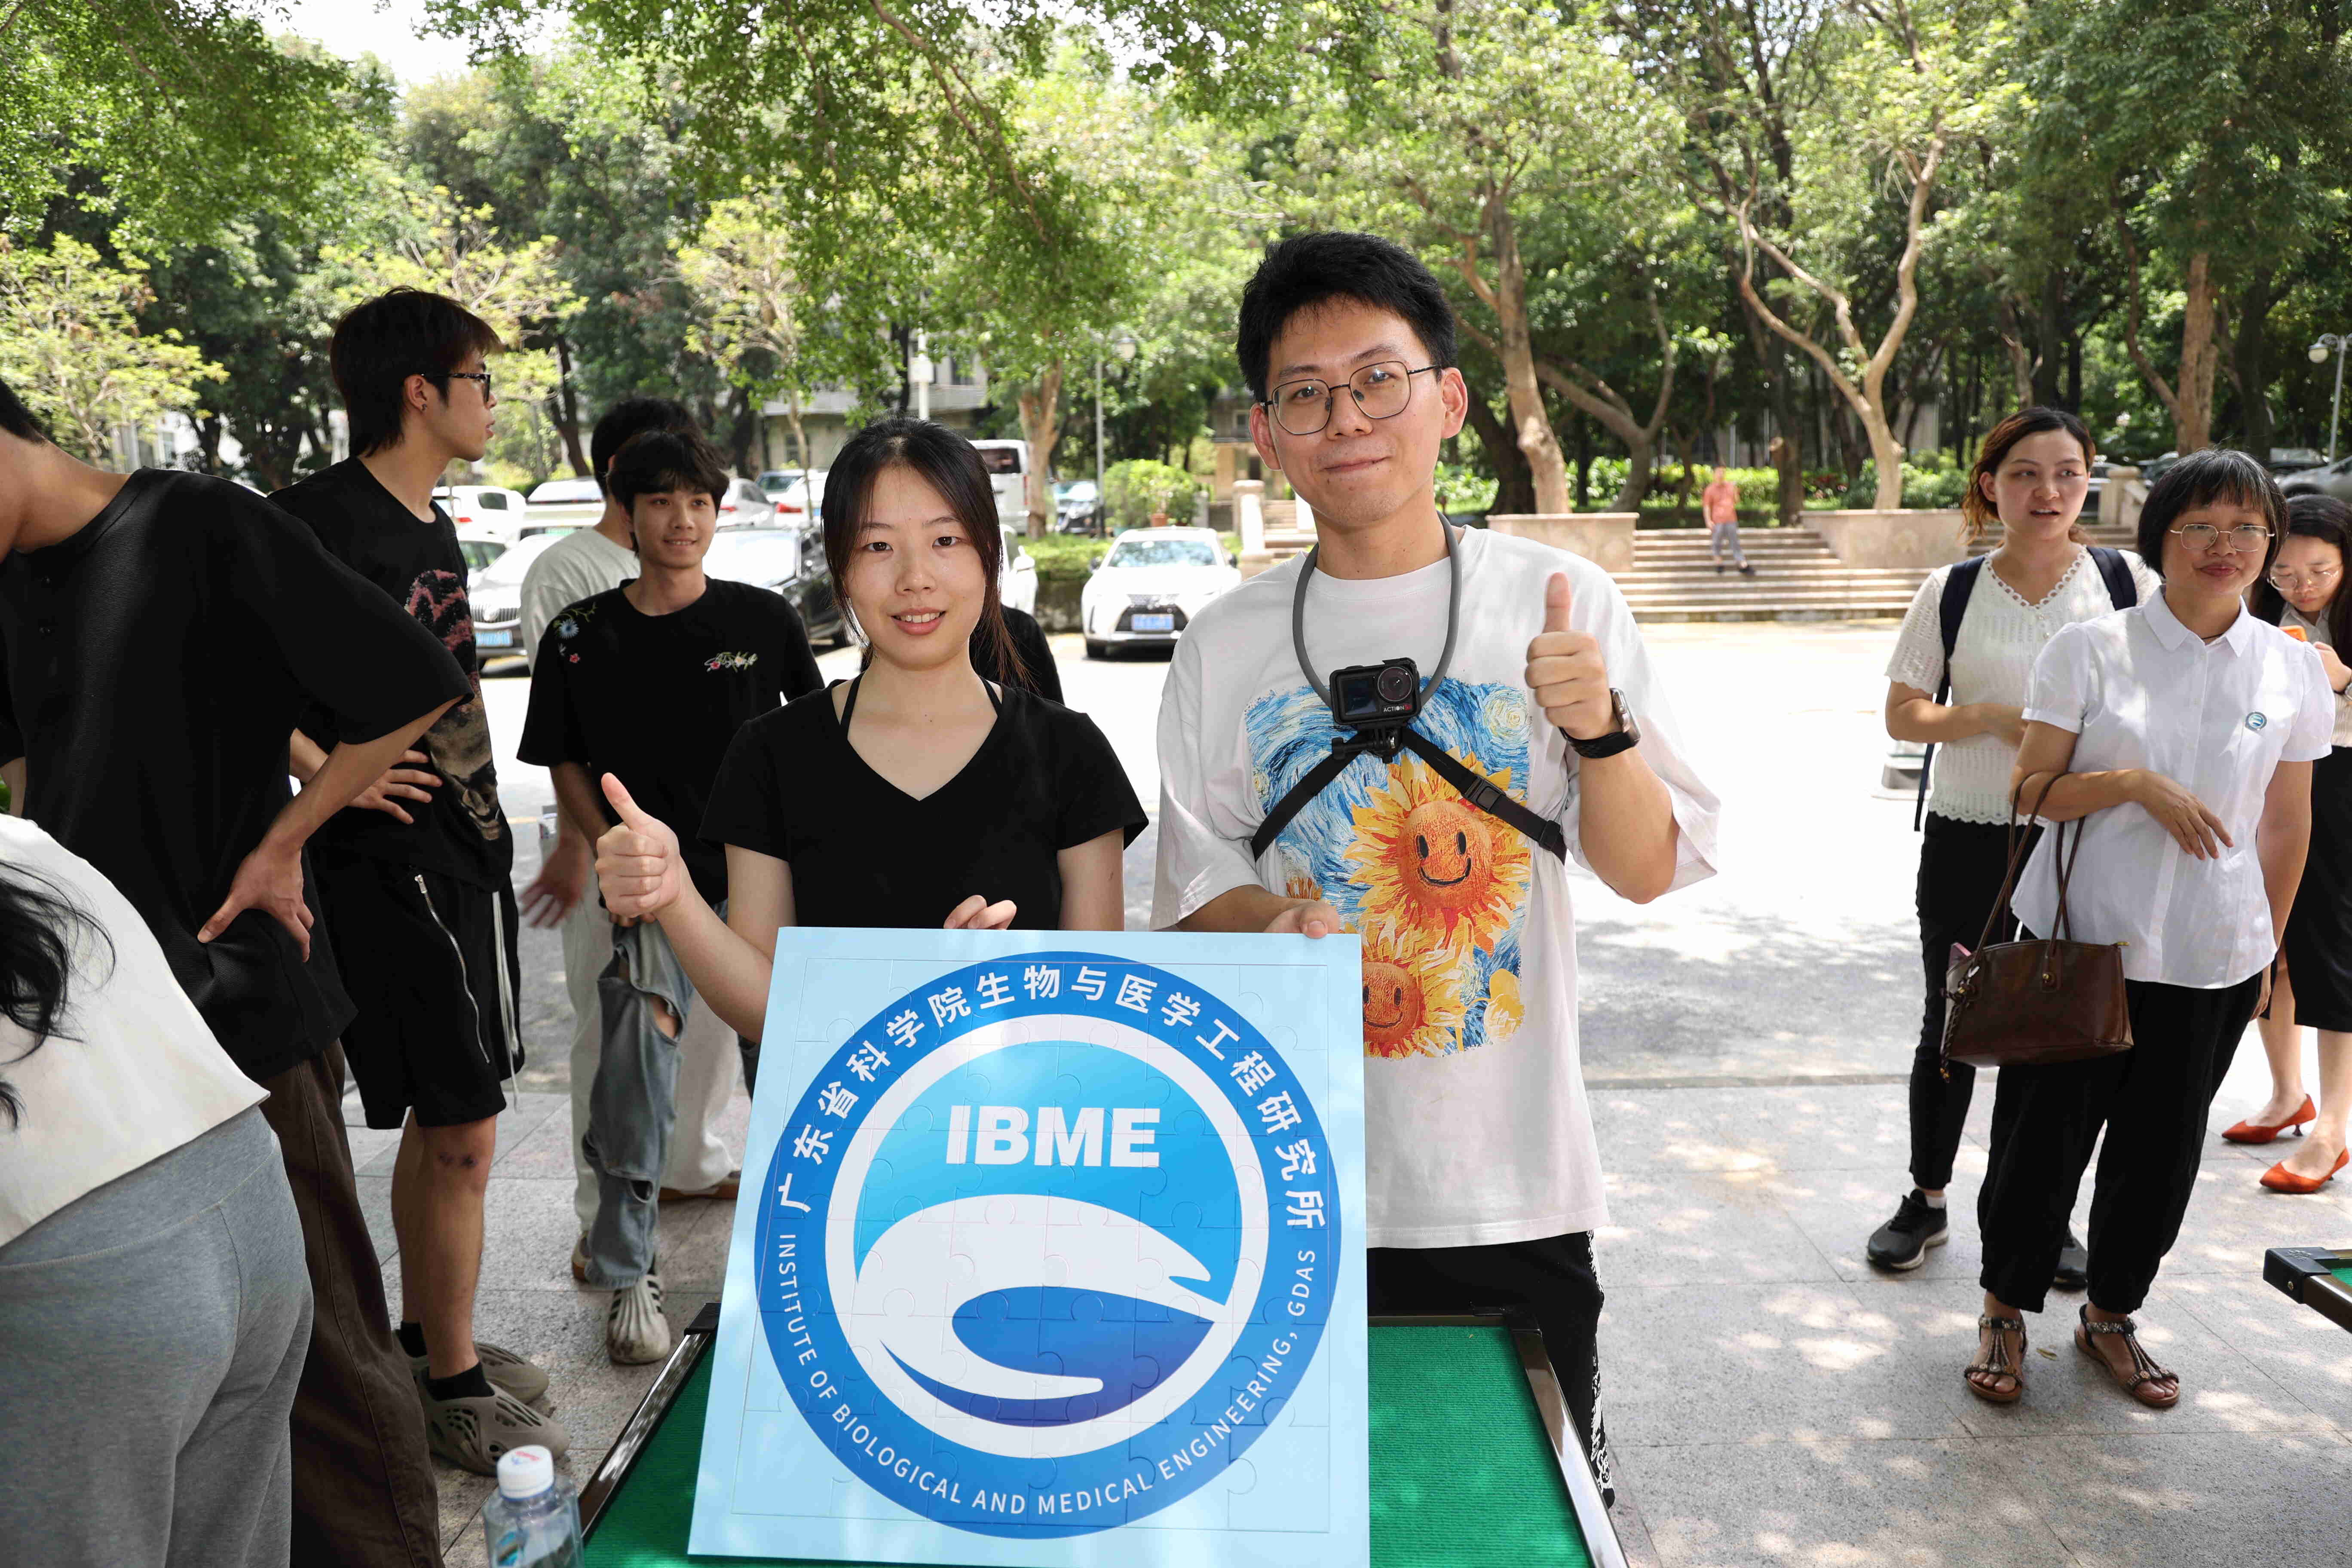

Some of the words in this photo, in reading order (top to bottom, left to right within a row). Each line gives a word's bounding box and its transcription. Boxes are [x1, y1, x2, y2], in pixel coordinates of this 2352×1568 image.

[777, 964, 1326, 1229] 广东省科学院生物与医学工程研究所
[945, 1105, 1161, 1168] IBME
[778, 1234, 818, 1366] INSTITUTE
[810, 1370, 838, 1399] OF
[831, 1403, 961, 1504] BIOLOGICAL
[971, 1489, 1026, 1515] AND
[1038, 1473, 1154, 1515] MEDICAL
[1157, 1332, 1298, 1481] ENGINEERING,
[1286, 1250, 1316, 1317] GDAS
